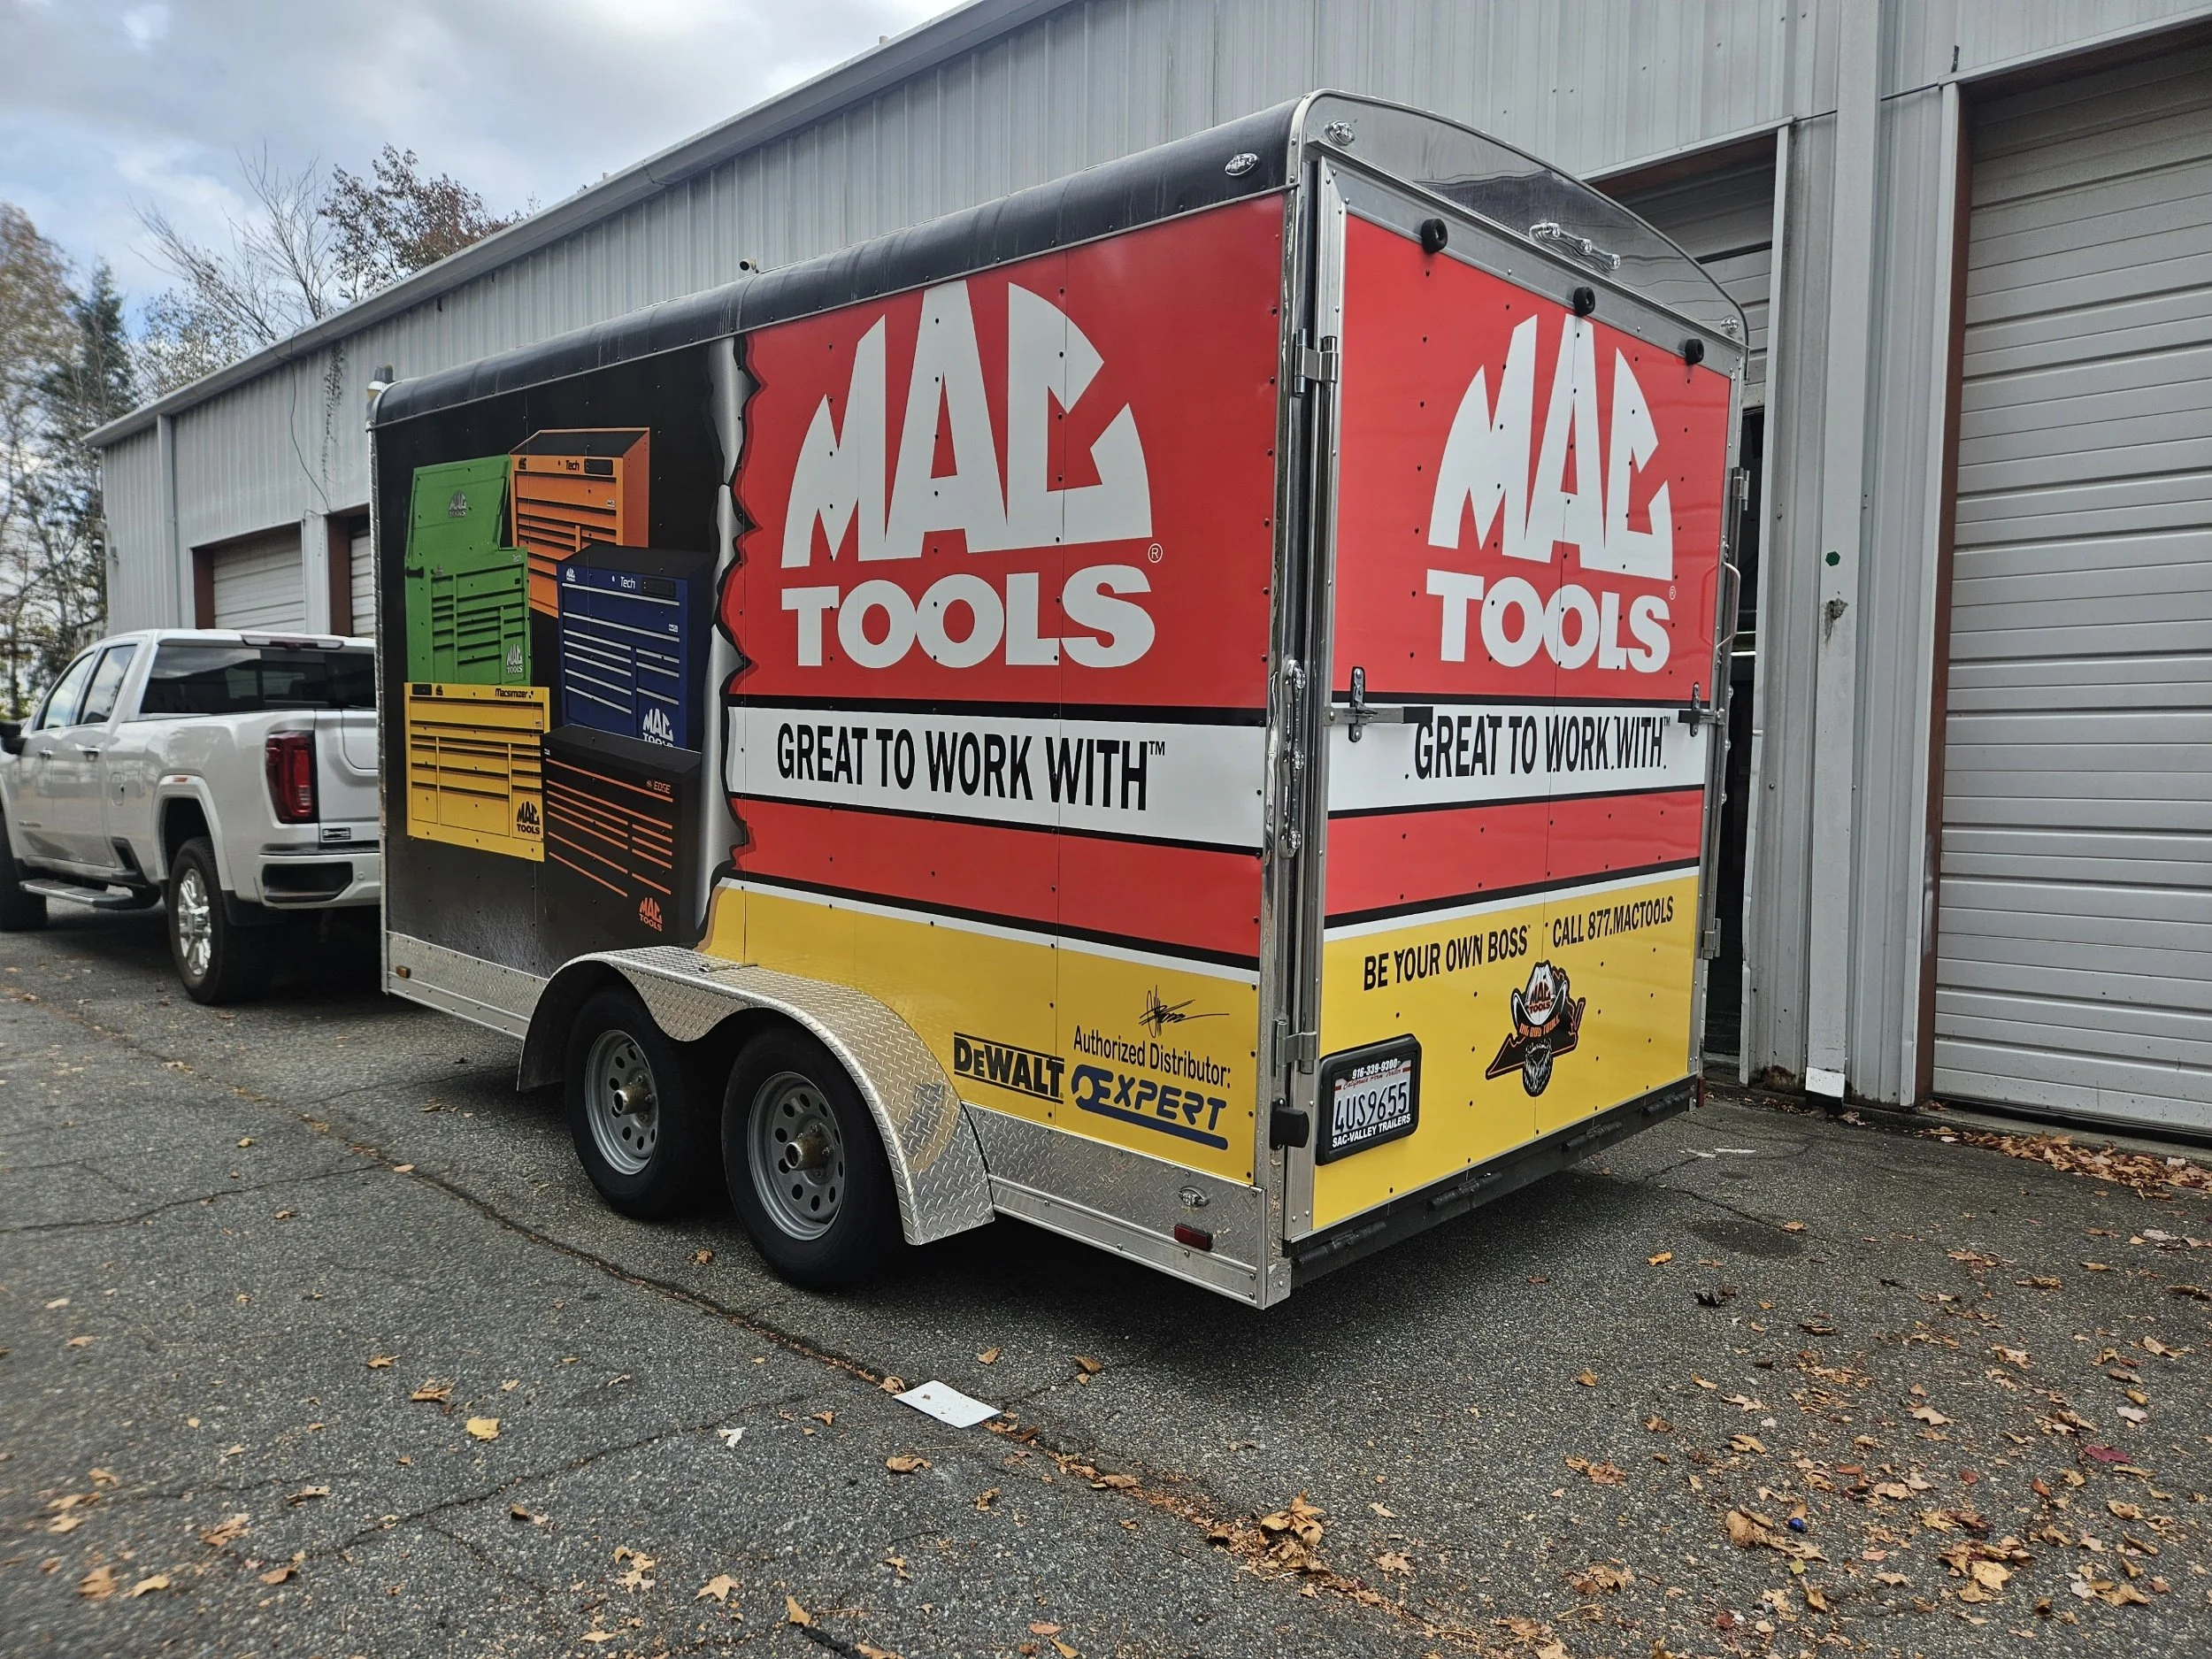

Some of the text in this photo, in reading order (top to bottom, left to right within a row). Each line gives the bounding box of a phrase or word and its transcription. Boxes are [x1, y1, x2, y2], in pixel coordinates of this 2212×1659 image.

[780, 280, 1153, 569] MAC
[1427, 313, 1673, 581] MAC
[565, 459, 580, 471] Tech
[620, 576, 636, 589] Tech
[780, 564, 1156, 669] TOOLS
[1425, 567, 1671, 673] TOOLS
[506, 644, 524, 665] MAC
[506, 664, 524, 675] TOOLS
[642, 708, 674, 741] MAC
[776, 722, 869, 786] GREAT
[875, 727, 916, 790] TO
[925, 730, 1033, 801] WORK
[1415, 715, 1503, 780] GREAT
[1508, 715, 1538, 775] TO
[1546, 715, 1611, 773] WORK
[516, 801, 541, 826] MAC
[516, 823, 541, 835] TOOLS
[639, 897, 663, 925] MAC
[639, 913, 663, 932] TOOLS
[1553, 895, 1674, 949] CALL 877.MACTOOLS
[1363, 953, 1389, 992] BE
[1394, 942, 1440, 984] YOUR
[1446, 933, 1484, 972] OWN
[1529, 981, 1551, 1006] MAC
[1529, 1001, 1551, 1015] TOOLS
[1073, 1025, 1232, 1089] Authorized Distributor:
[1351, 1057, 1399, 1079] 916-339-9300
[1071, 1064, 1228, 1132] EXPERT
[1334, 1081, 1407, 1133] 4US9655
[1332, 1113, 1411, 1148] SAC-VALLEY TRAILERS
